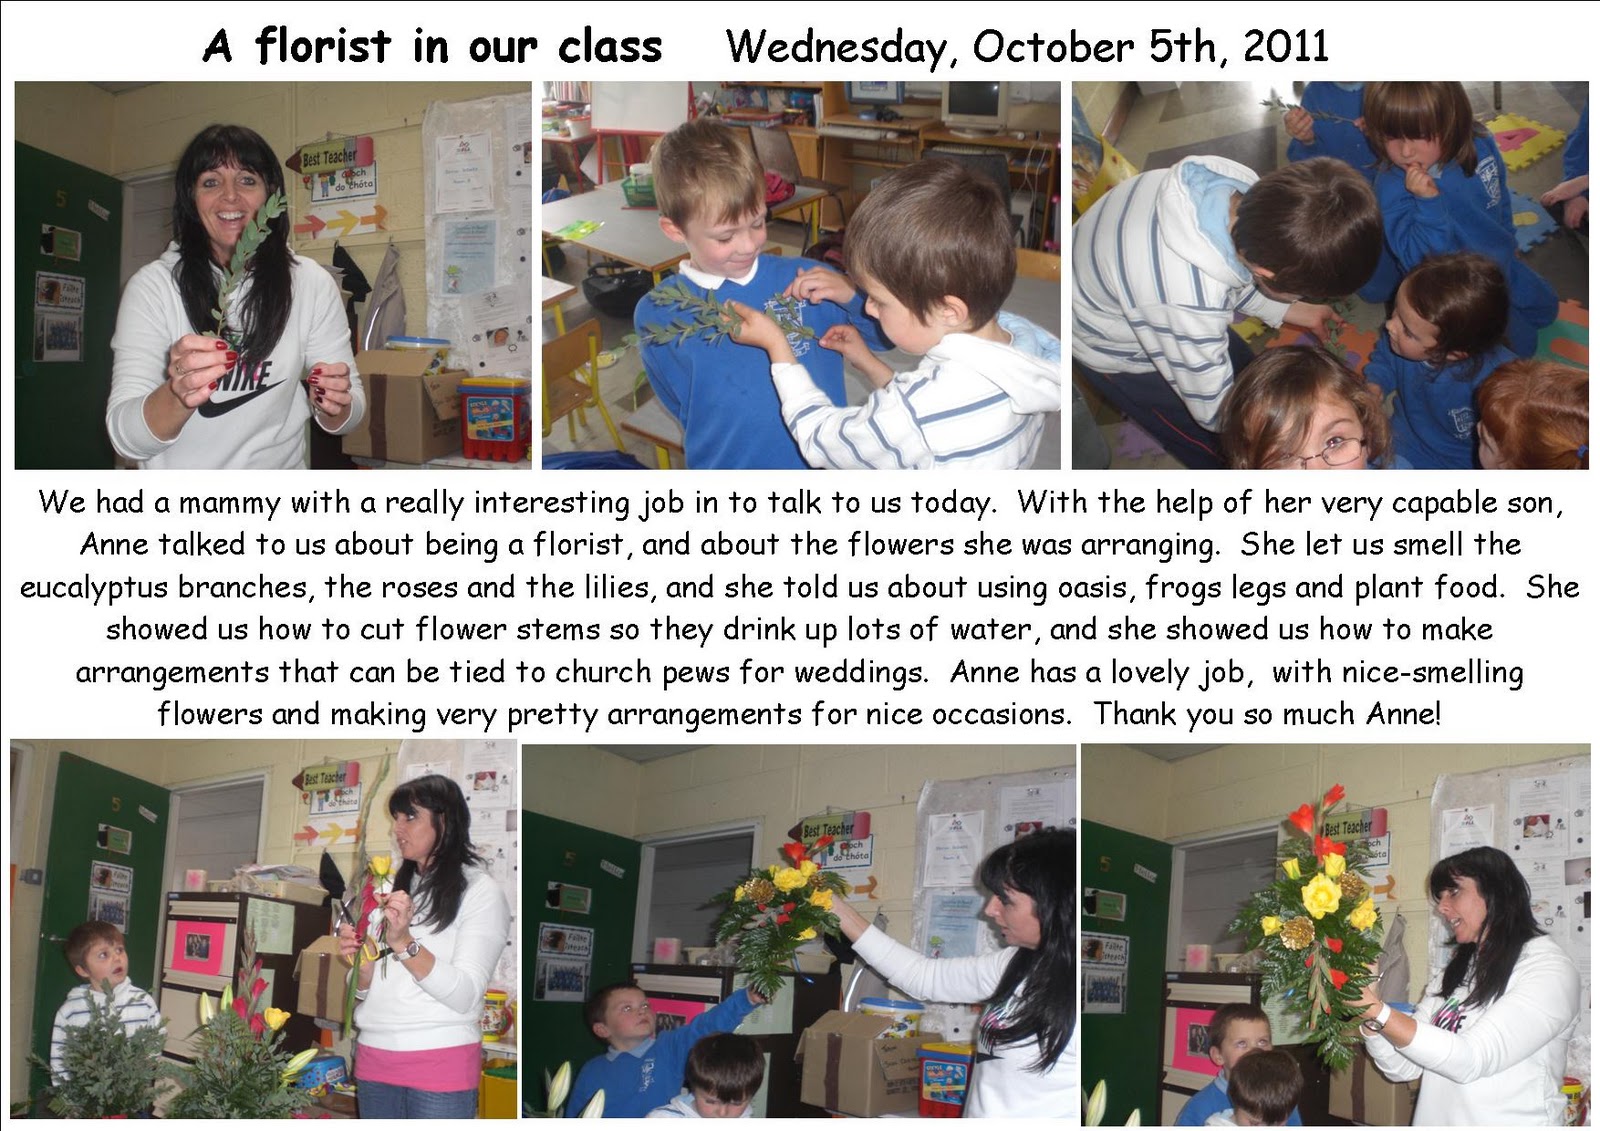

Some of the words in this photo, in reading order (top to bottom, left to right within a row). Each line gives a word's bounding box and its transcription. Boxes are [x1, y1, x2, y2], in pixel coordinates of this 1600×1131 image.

[303, 152, 320, 168] Best
[324, 148, 357, 163] Teacher
[341, 167, 366, 179] coch
[335, 183, 346, 192] do
[305, 773, 318, 785] Best
[321, 771, 346, 784] Teacher
[803, 825, 820, 839] Best
[823, 821, 854, 836] Teacher
[1325, 823, 1339, 836] Best
[1342, 819, 1372, 834] Teacher
[833, 854, 842, 862] do
